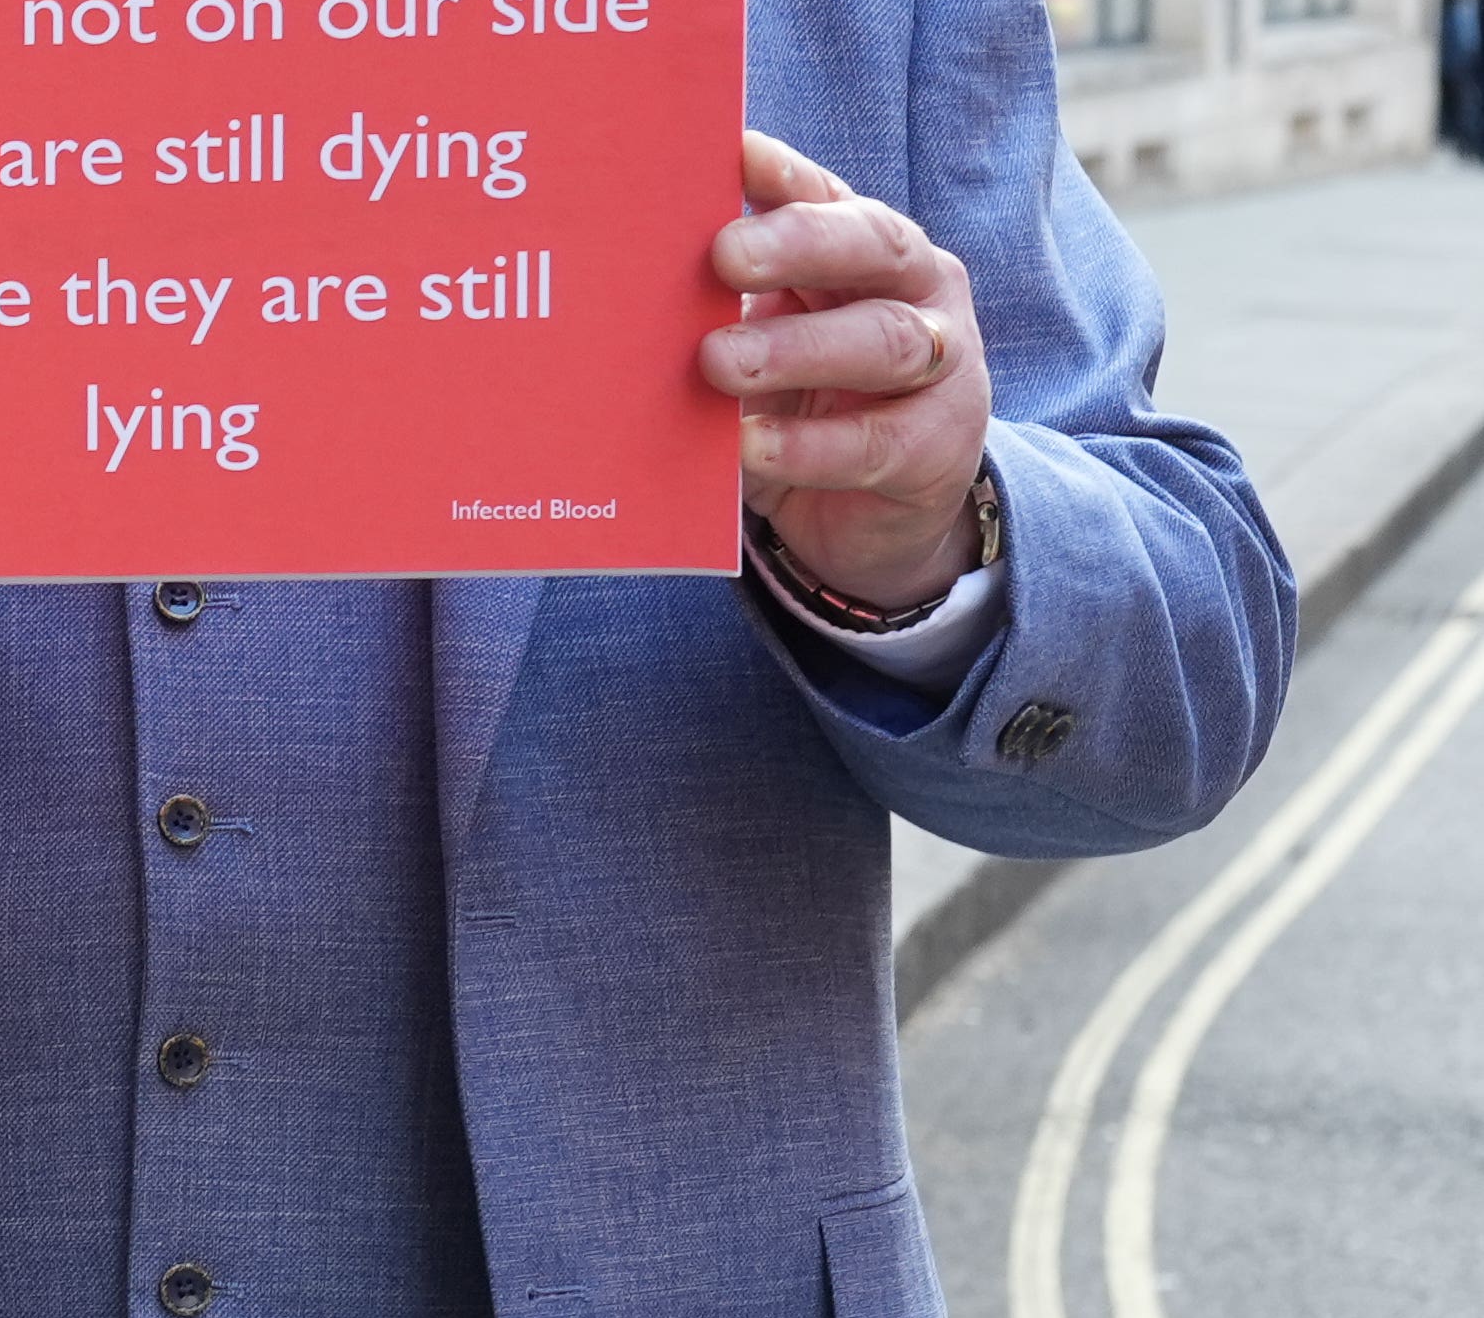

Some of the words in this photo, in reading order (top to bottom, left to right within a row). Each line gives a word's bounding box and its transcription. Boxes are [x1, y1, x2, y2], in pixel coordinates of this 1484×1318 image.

[0, 138, 122, 186] are
[156, 114, 283, 183] still
[320, 112, 527, 201] dying
[61, 258, 232, 344] they
[262, 275, 386, 322] are
[420, 251, 550, 320] still
[88, 385, 259, 472] lying
[452, 499, 542, 520] Infected
[550, 498, 616, 519] Blood
